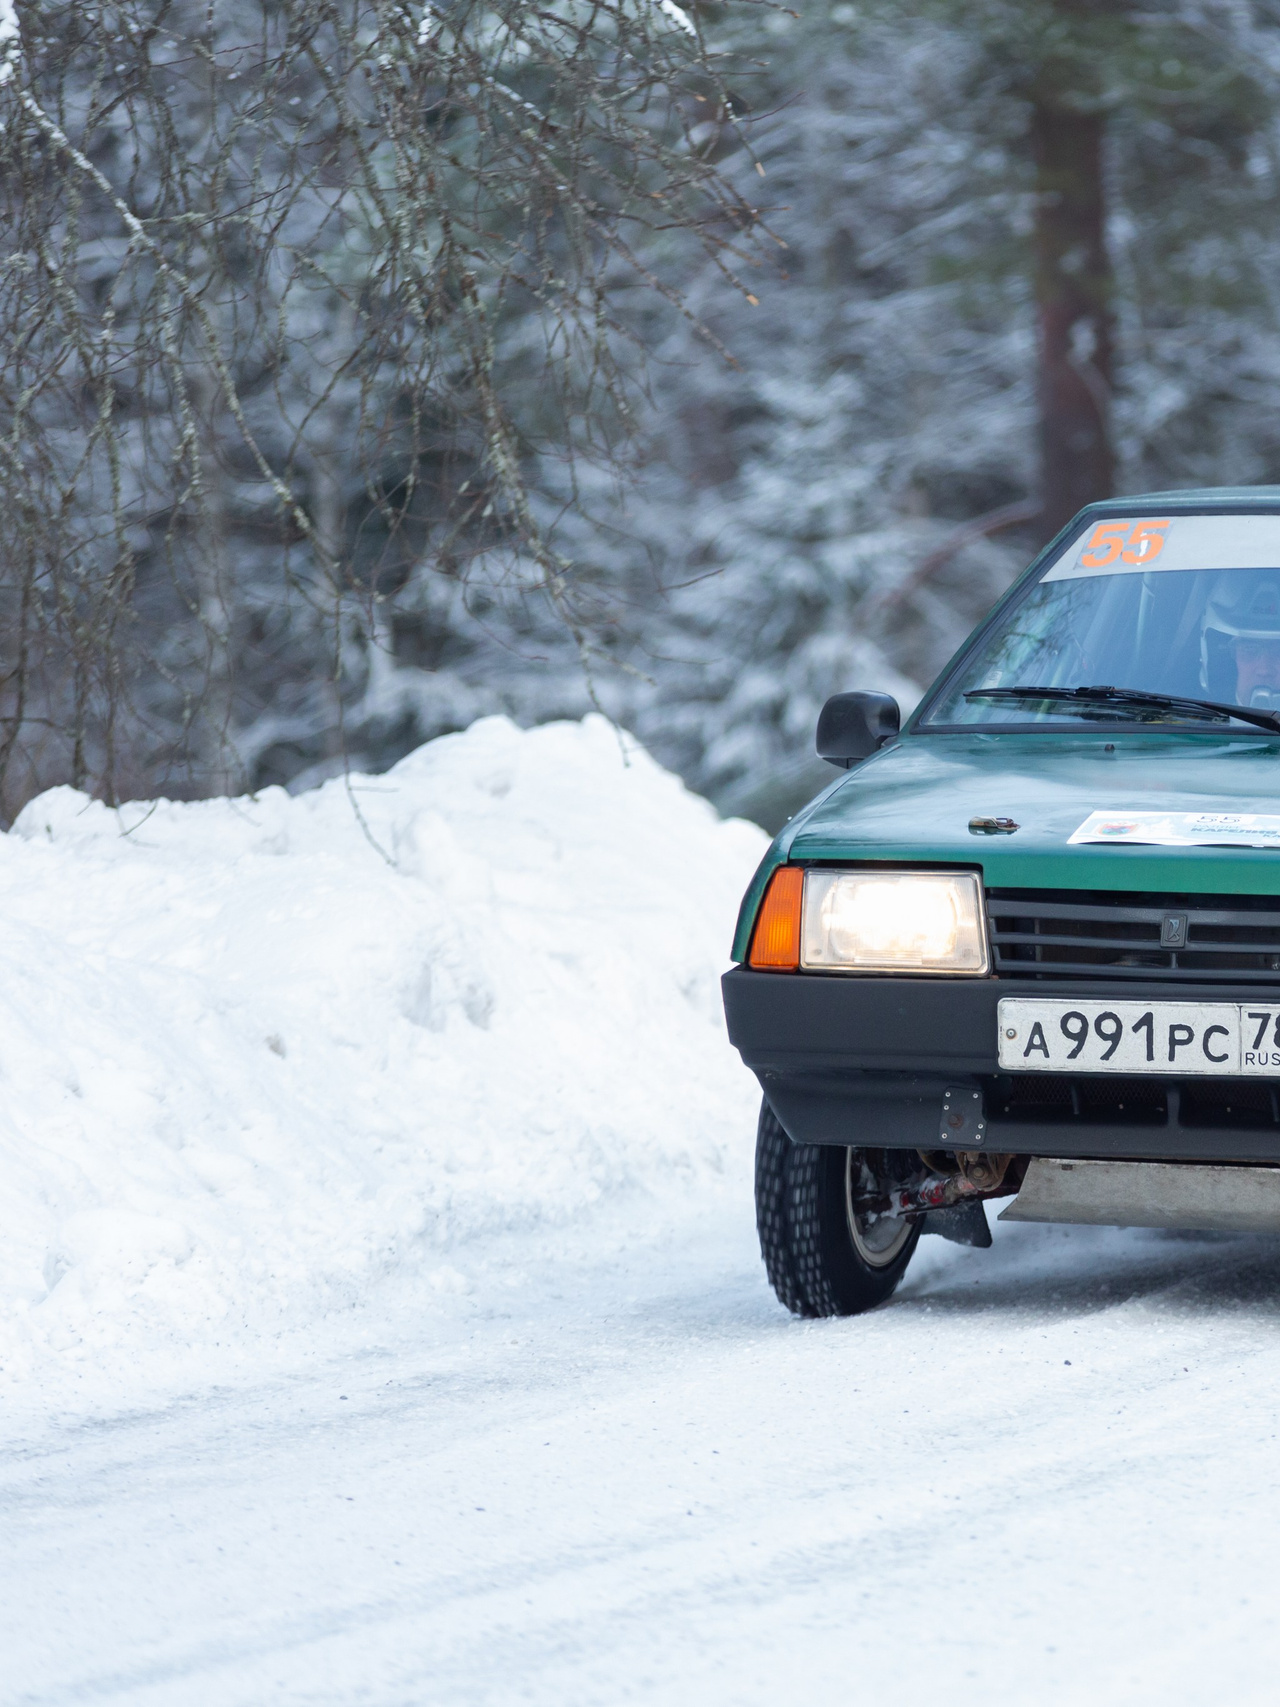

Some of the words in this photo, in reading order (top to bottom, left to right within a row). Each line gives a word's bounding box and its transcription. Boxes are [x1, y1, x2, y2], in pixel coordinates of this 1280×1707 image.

[1081, 520, 1170, 568] 55
[1196, 815, 1242, 824] 55
[1245, 1052, 1280, 1066] RUS
